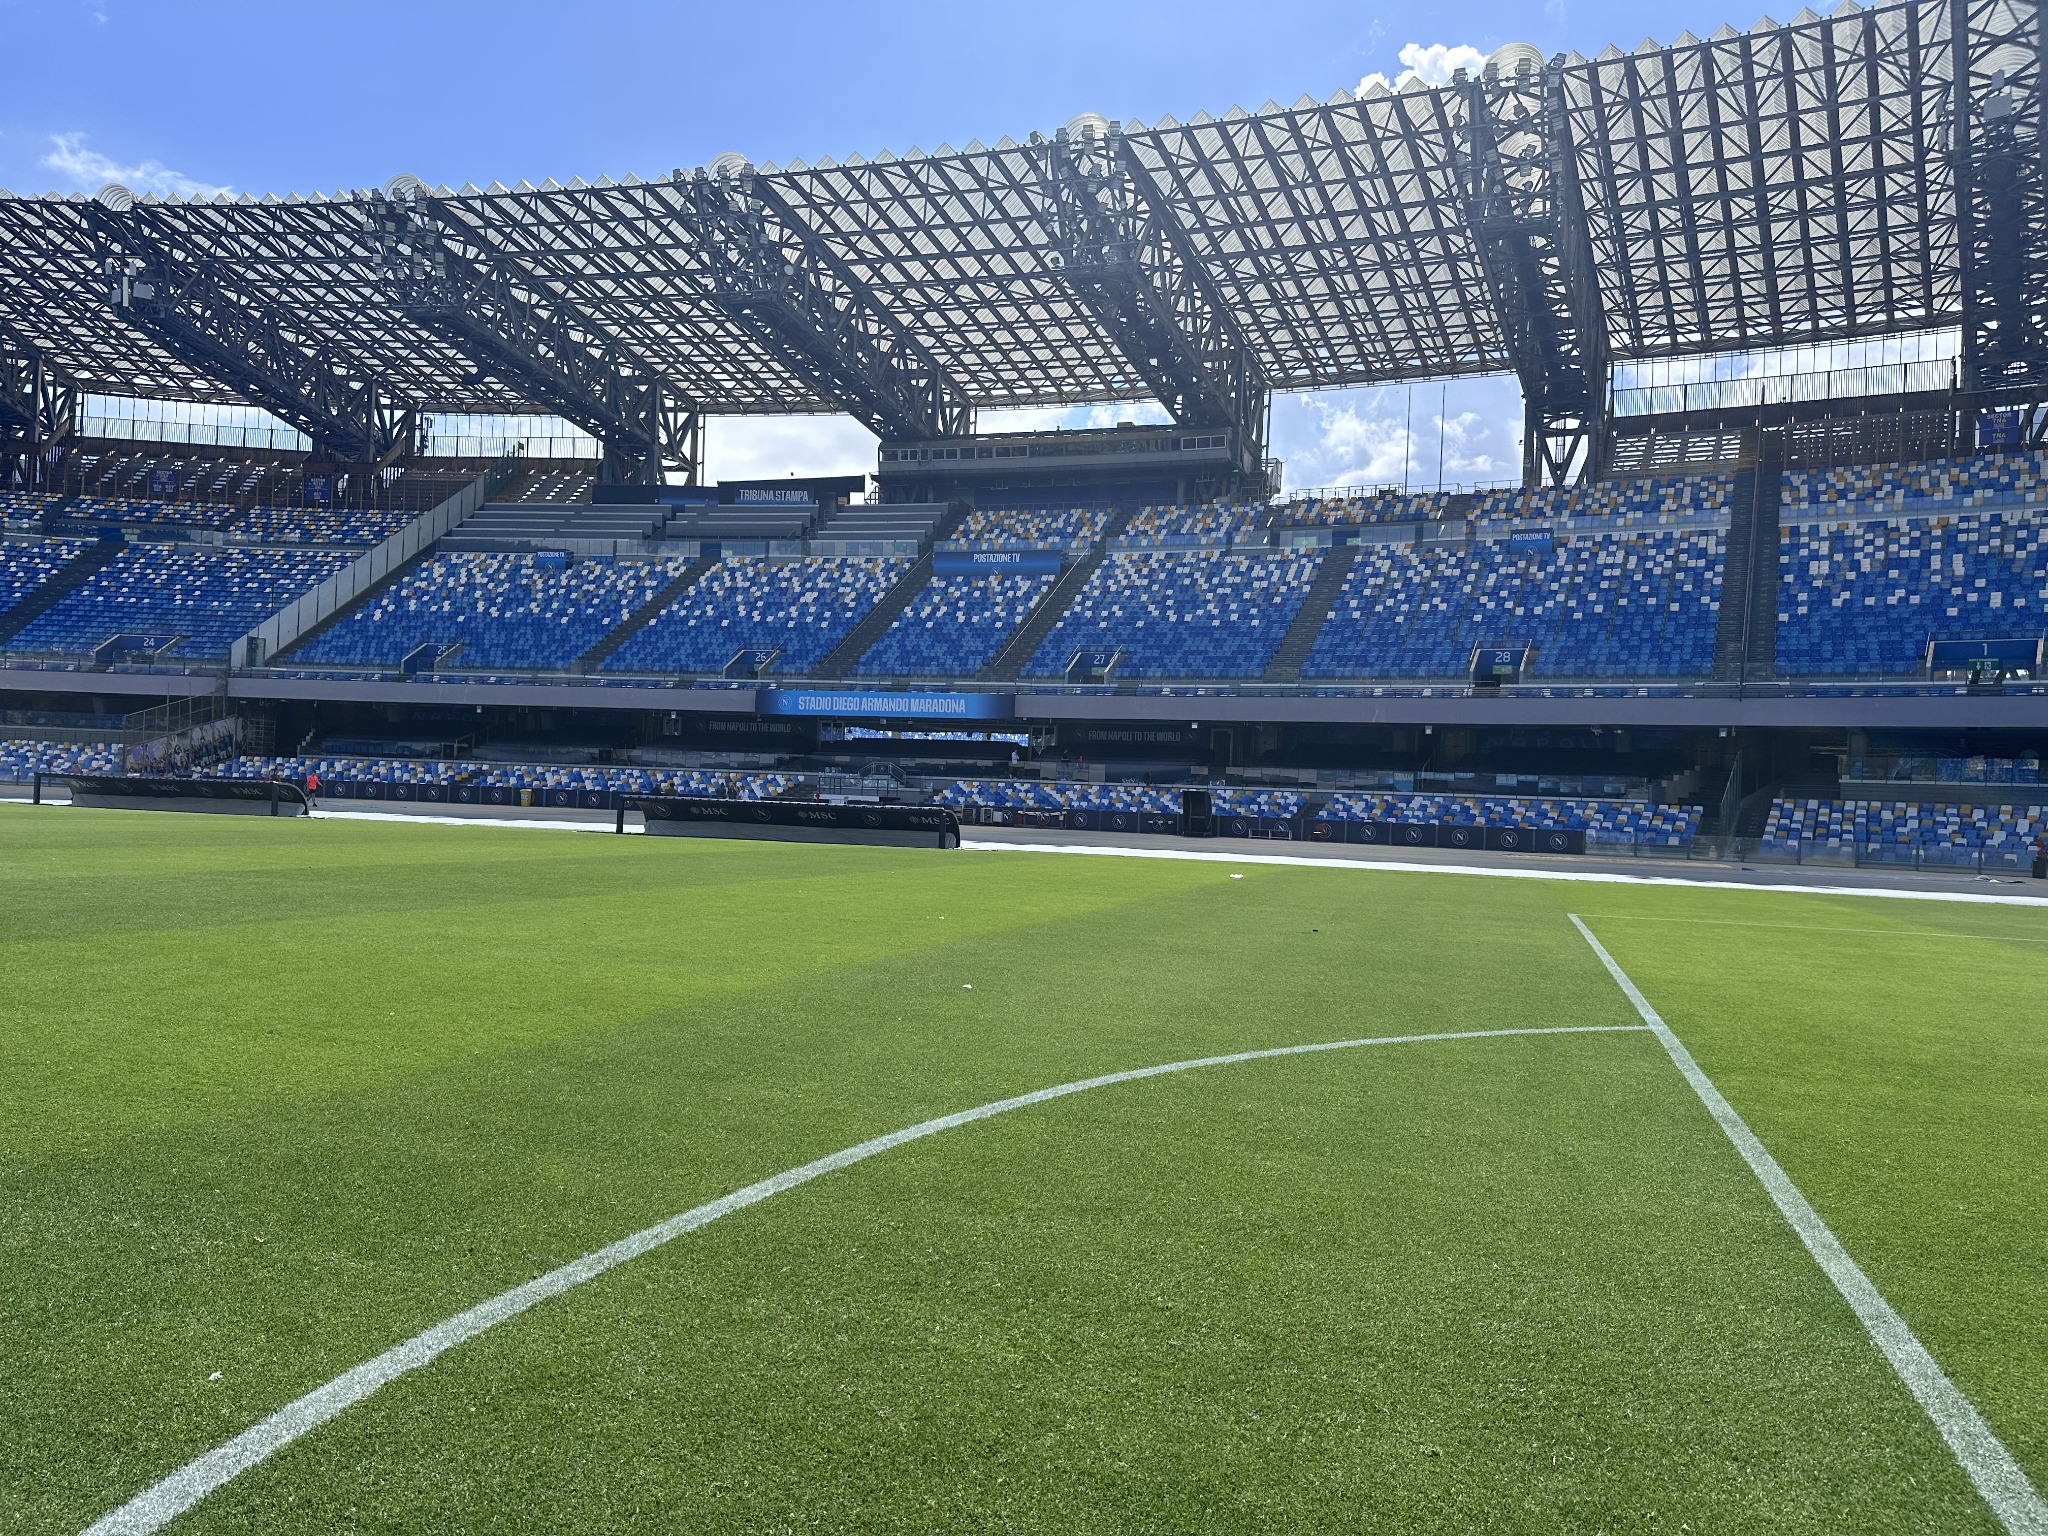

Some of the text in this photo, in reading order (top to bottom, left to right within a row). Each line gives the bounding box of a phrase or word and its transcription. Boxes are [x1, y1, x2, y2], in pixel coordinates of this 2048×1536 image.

[739, 489, 808, 501] TRIBUNA STAMPA
[1512, 532, 1551, 541] POSTAZIONE TV
[973, 553, 1020, 563] POSTAZIONE TV
[143, 638, 154, 646] 24
[438, 646, 448, 655] 25
[1982, 643, 1987, 655] 1
[755, 652, 766, 661] 26
[1094, 655, 1105, 664] 27
[1495, 651, 1511, 662] 28
[799, 696, 831, 711] STADIO
[833, 697, 860, 711] DIEGO
[861, 697, 908, 712] ARMANDO
[910, 698, 966, 713] MARADONA
[709, 721, 726, 730] FROM
[727, 722, 748, 731] NAPOLI
[749, 722, 757, 732] TO
[758, 723, 769, 732] THE
[770, 723, 791, 733] WORLD
[1088, 731, 1108, 740] FROM
[1108, 731, 1132, 741] NAPOLI
[1133, 731, 1142, 741] TO
[1143, 732, 1156, 741] THE
[1156, 732, 1181, 742] WORLD
[702, 807, 729, 816] MSC
[809, 811, 837, 820] MSC
